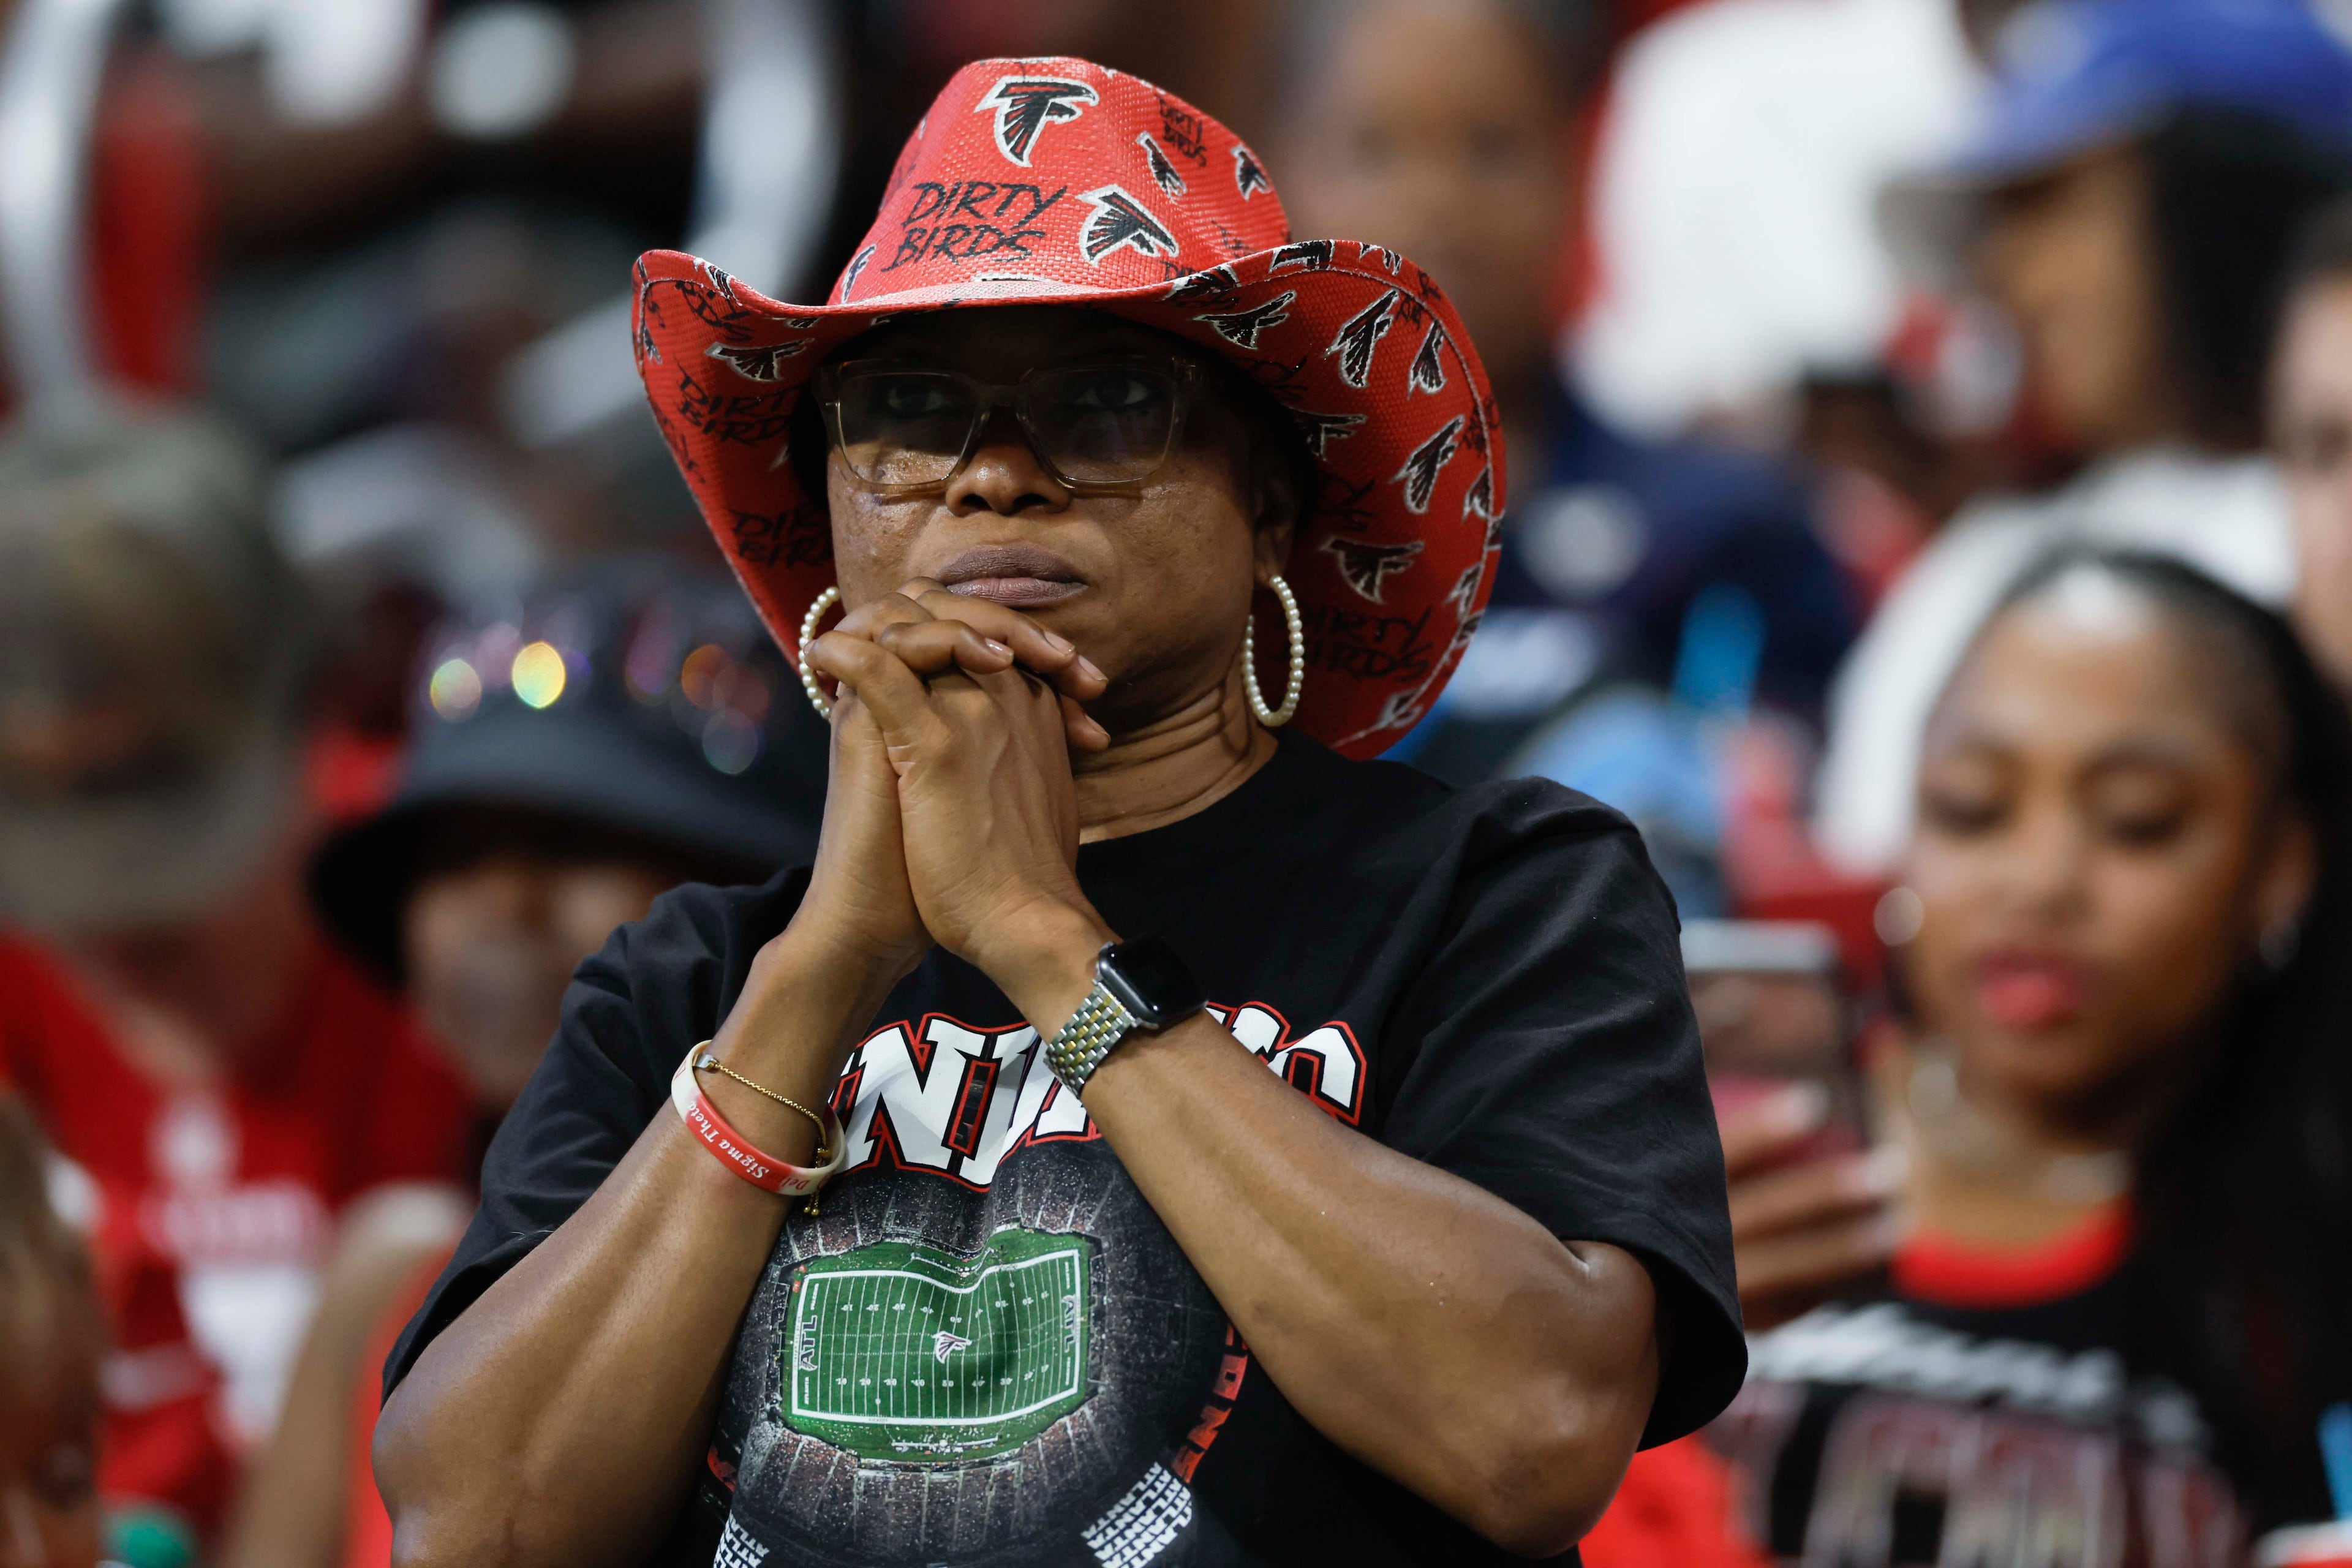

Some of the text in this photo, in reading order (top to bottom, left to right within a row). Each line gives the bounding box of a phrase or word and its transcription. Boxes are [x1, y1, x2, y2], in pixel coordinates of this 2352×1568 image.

[901, 181, 1067, 232] DIRTY
[881, 224, 1045, 273] BIRDS
[676, 359, 804, 418] DIRT
[677, 399, 794, 447] BIRD
[687, 1101, 720, 1144] Theta
[718, 1139, 770, 1179] Sigma
[799, 1314, 818, 1371] ATL
[1080, 1461, 1163, 1539] ATLANTA
[1086, 1469, 1172, 1550] ATLANTA
[1094, 1477, 1183, 1561] ATLANTA
